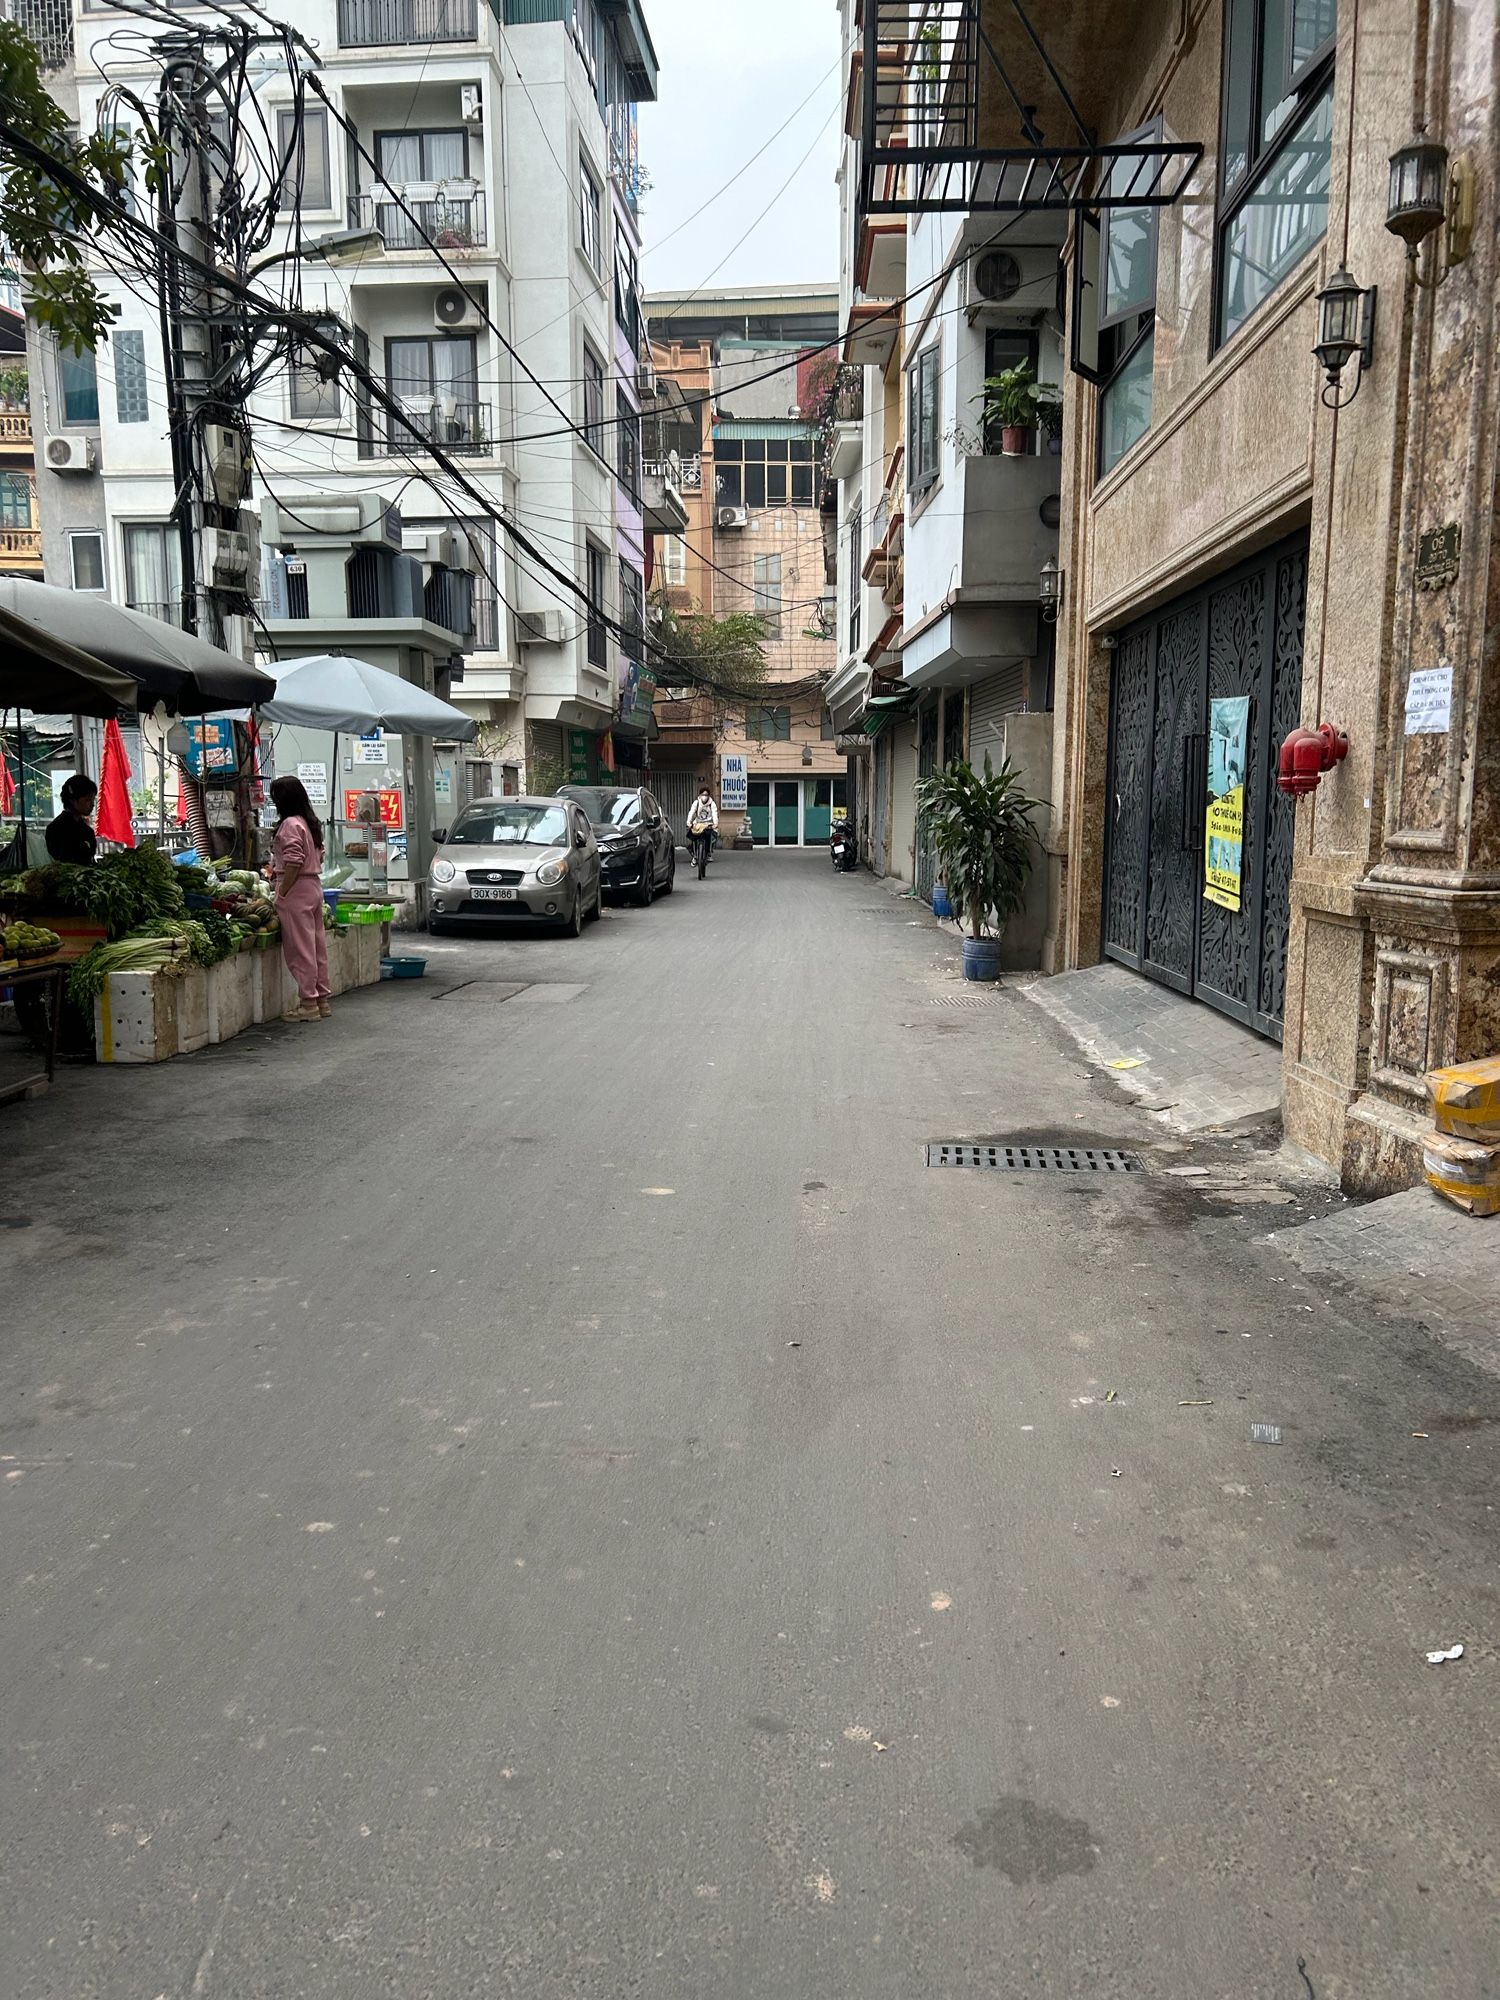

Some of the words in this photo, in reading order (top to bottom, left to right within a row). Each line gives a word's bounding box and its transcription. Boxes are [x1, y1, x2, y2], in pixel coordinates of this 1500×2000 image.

[1432, 536, 1445, 550] 09
[726, 756, 742, 772] NHÀ
[722, 774, 746, 791] THUỐC
[473, 889, 512, 899] 30X-9186
